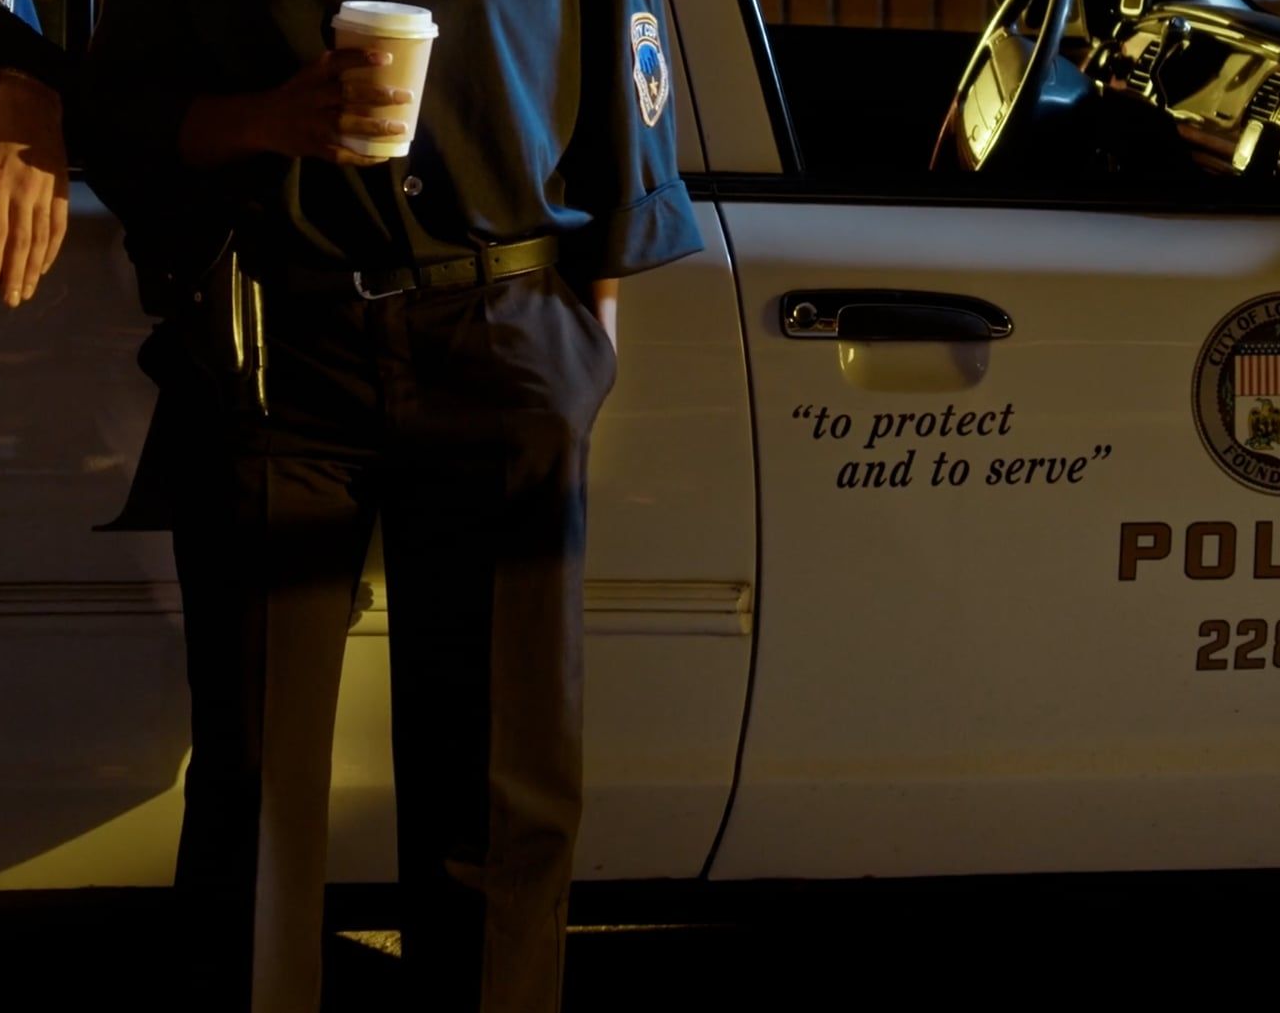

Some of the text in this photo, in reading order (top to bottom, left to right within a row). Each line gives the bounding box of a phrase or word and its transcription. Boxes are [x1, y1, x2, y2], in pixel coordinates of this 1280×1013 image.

[1208, 328, 1237, 366] CITY
[1236, 309, 1260, 331] OF
[863, 403, 1016, 449] protect
[836, 449, 917, 489] and
[930, 451, 970, 487] to
